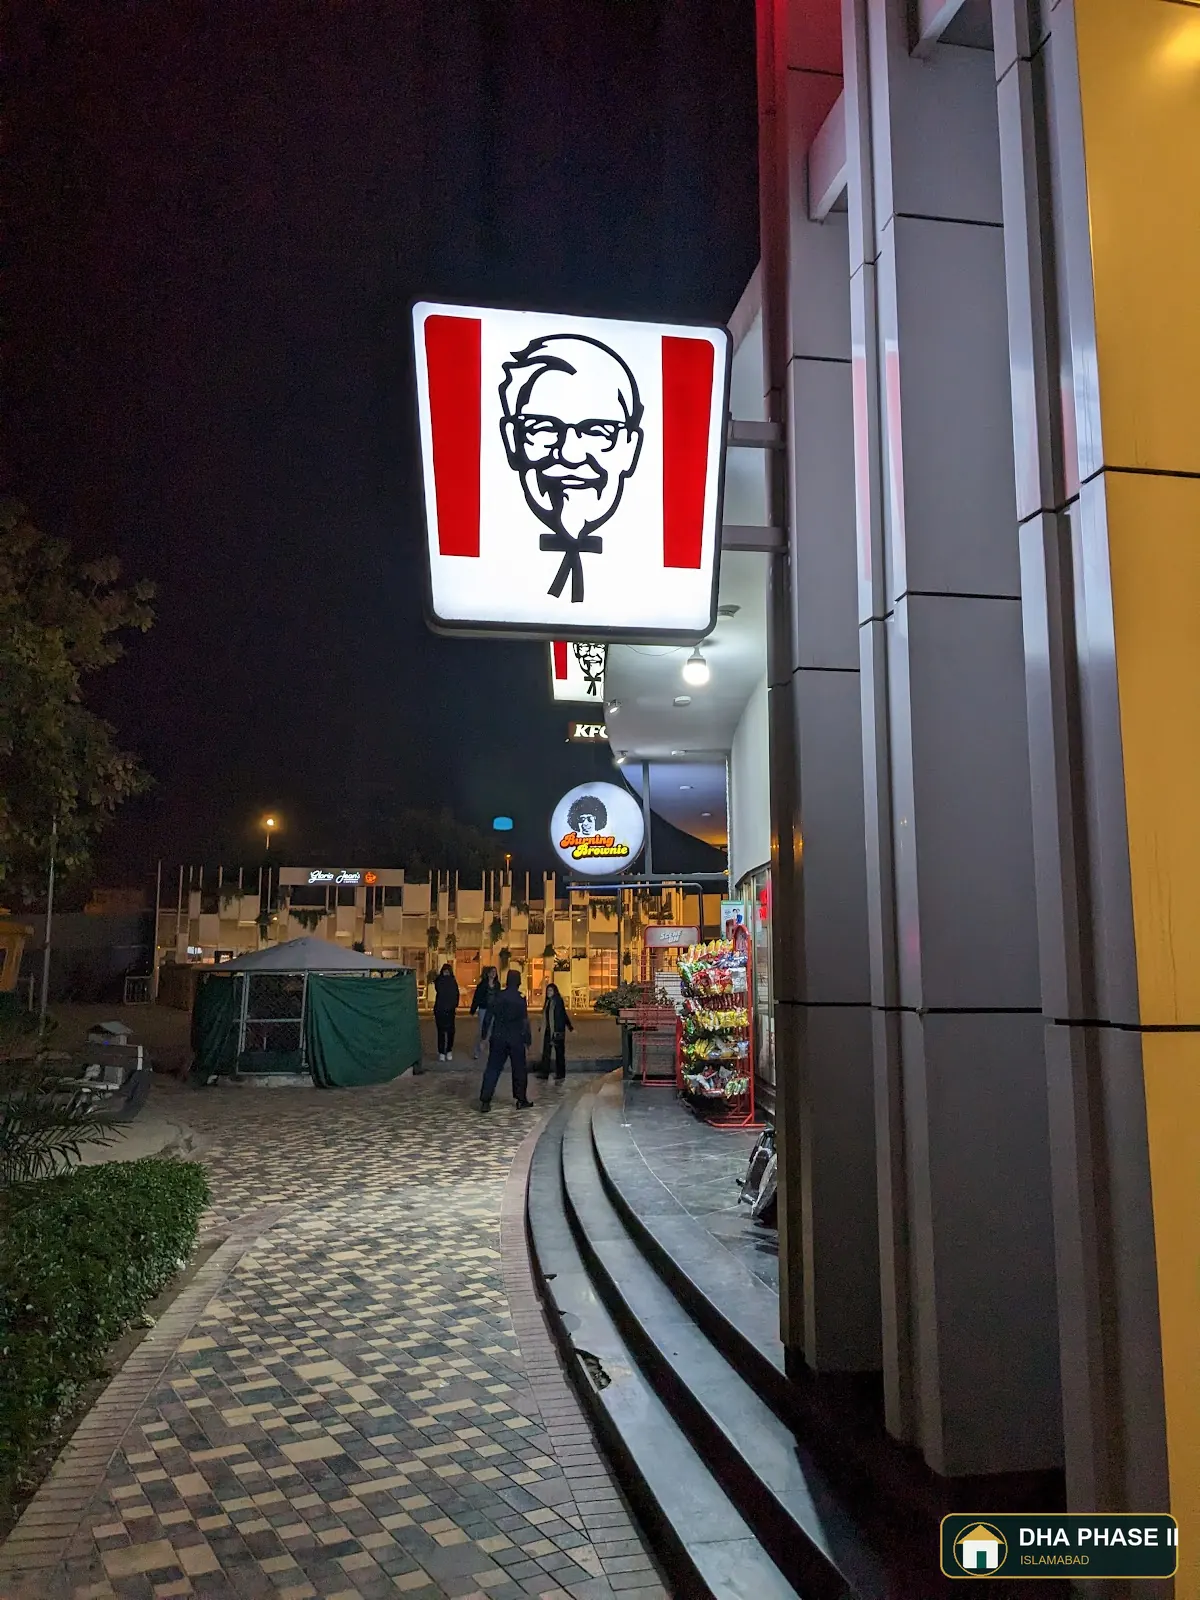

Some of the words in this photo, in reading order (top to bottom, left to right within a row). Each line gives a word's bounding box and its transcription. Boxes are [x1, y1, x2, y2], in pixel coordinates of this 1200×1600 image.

[560, 832, 615, 848] Burning
[572, 843, 629, 859] Brownie
[308, 870, 334, 883] Gloria
